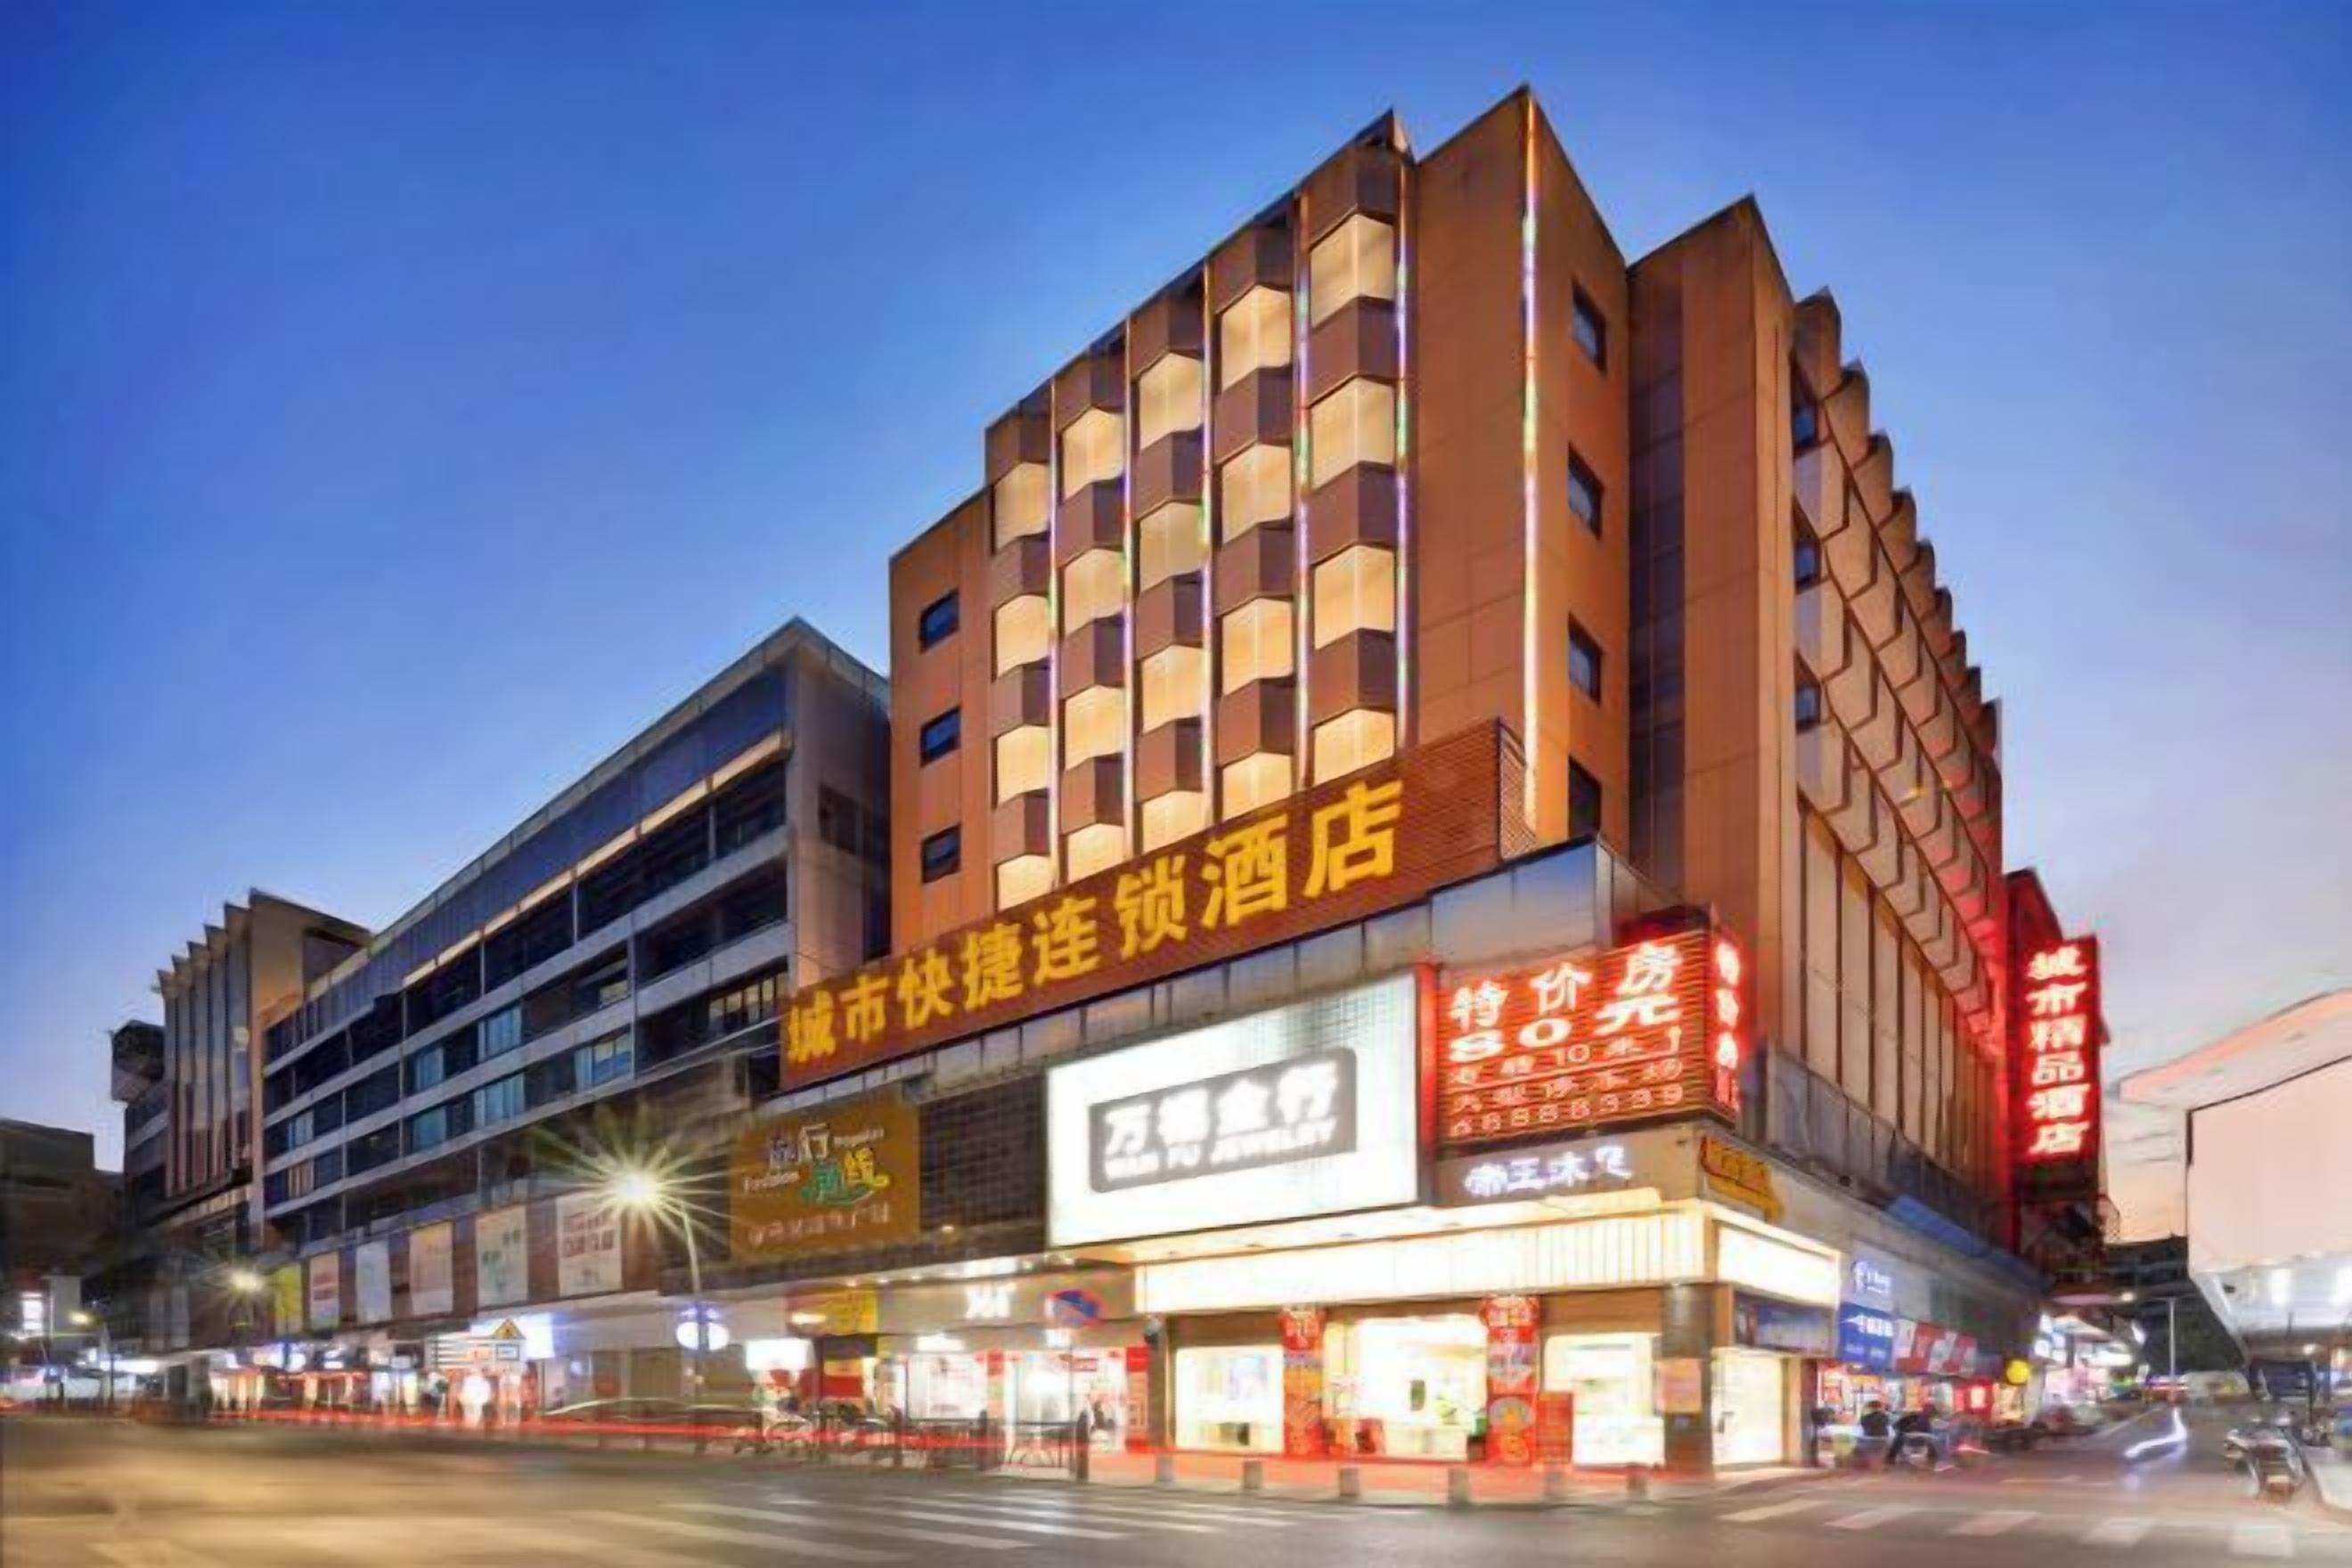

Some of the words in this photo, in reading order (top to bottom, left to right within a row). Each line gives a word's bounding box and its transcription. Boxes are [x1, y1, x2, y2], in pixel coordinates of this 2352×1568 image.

[787, 779, 1403, 1064] 城市快捷连锁酒店
[1450, 941, 1683, 1030] 特价房
[2026, 944, 2091, 1155] 城市精品酒店
